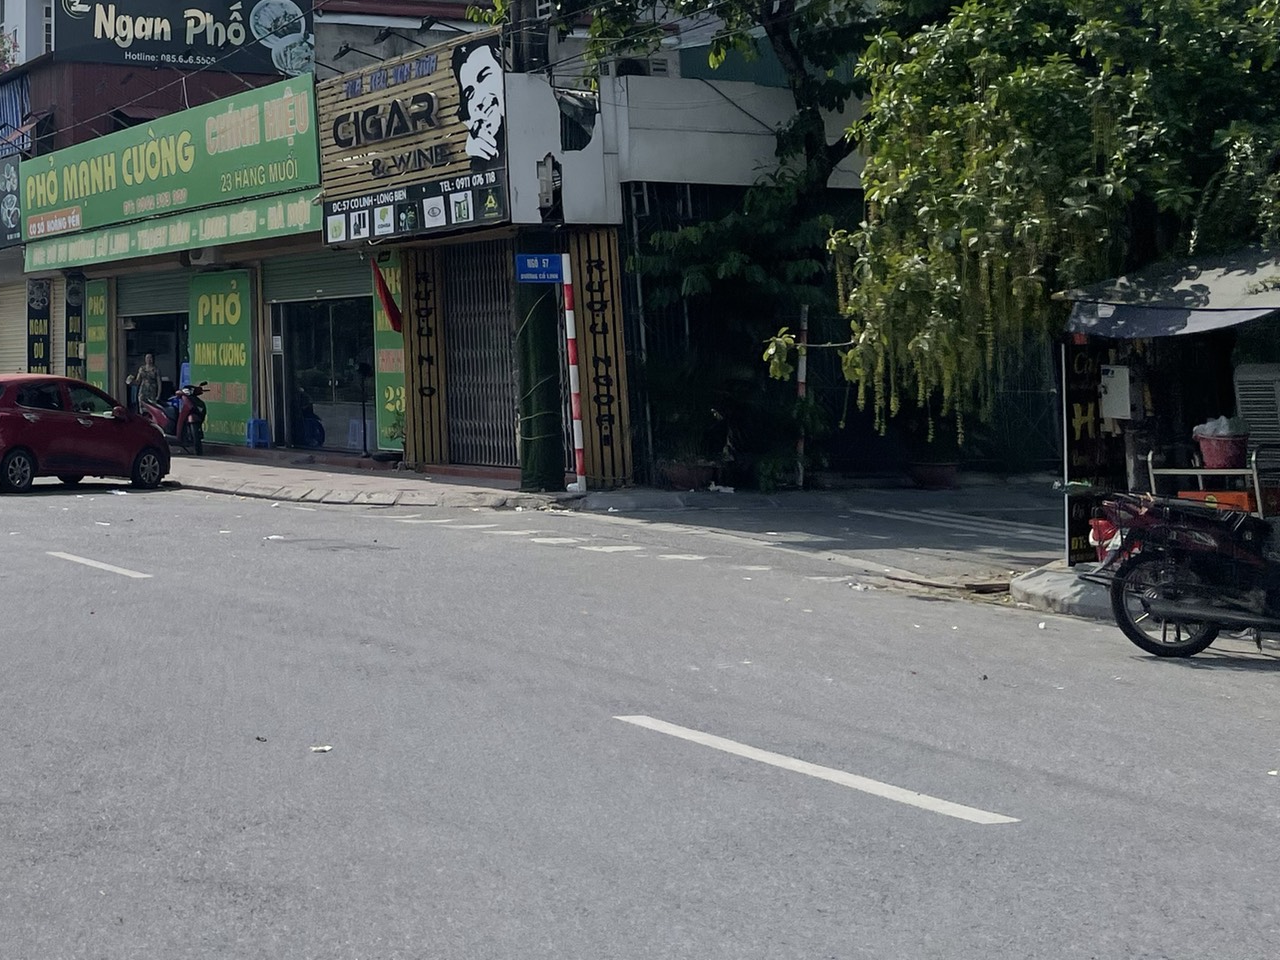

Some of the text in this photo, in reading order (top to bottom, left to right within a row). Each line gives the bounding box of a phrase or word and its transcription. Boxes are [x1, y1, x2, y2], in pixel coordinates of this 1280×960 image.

[93, 1, 246, 48] Ngan Phố
[124, 51, 158, 61] Hotline:
[205, 87, 310, 155] CHÍNH HIỆU
[333, 92, 439, 149] CIGAR
[26, 127, 195, 209] PHỞ MẠNH CƯỜNG
[221, 151, 298, 192] 23 HÀNG MUỐI
[371, 143, 454, 177] & WINE
[455, 176, 470, 190] 0911
[485, 172, 496, 184] 118
[286, 197, 311, 230] NỘI
[542, 258, 549, 268] 57
[198, 280, 241, 325] PHỞ
[29, 319, 48, 335] NGAN
[384, 386, 405, 413] 23
